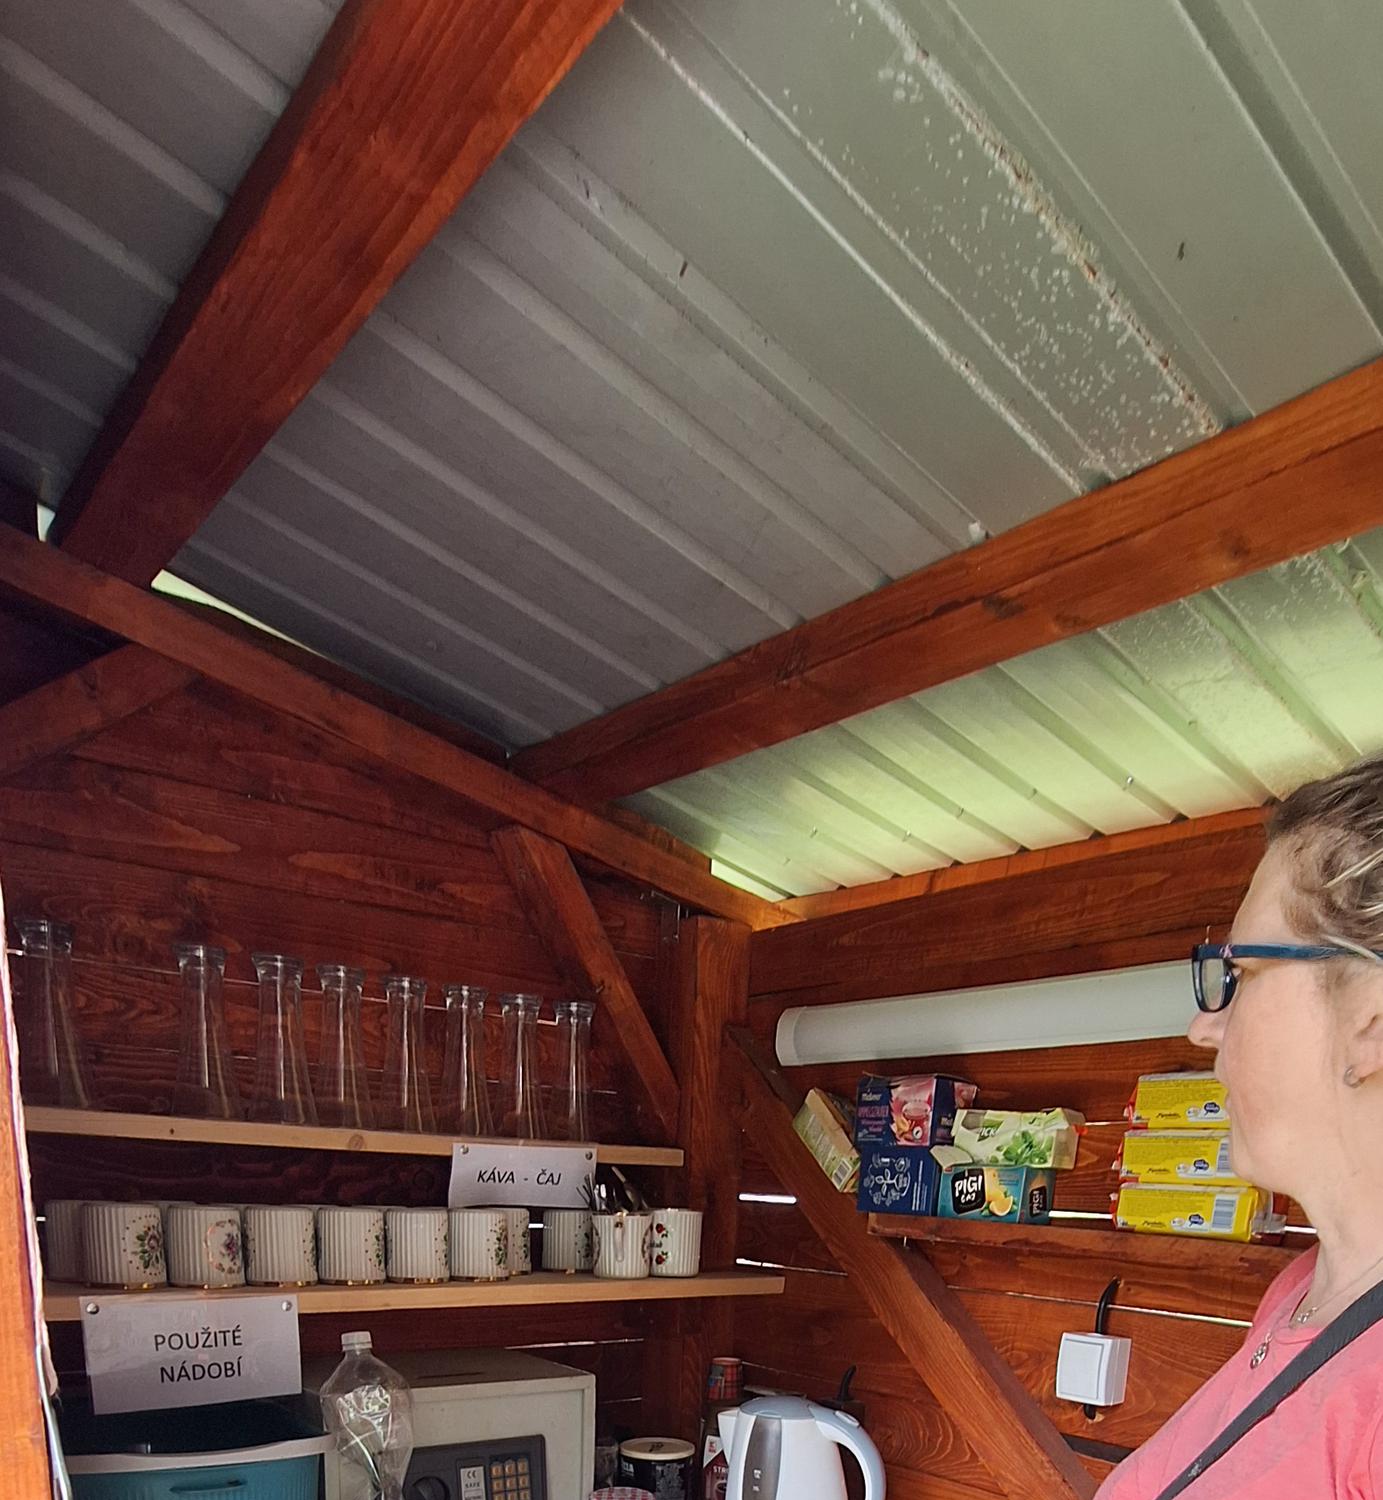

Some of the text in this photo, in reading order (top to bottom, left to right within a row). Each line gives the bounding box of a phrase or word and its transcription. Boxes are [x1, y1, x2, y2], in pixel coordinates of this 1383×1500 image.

[477, 1167, 515, 1184] KÁVA
[536, 1169, 562, 1186] ČAJ
[955, 1175, 983, 1198] PIGI
[154, 1325, 243, 1351] POUŽITÉ
[160, 1356, 243, 1383] NÁDOBÍ
[713, 1465, 728, 1473] STR
